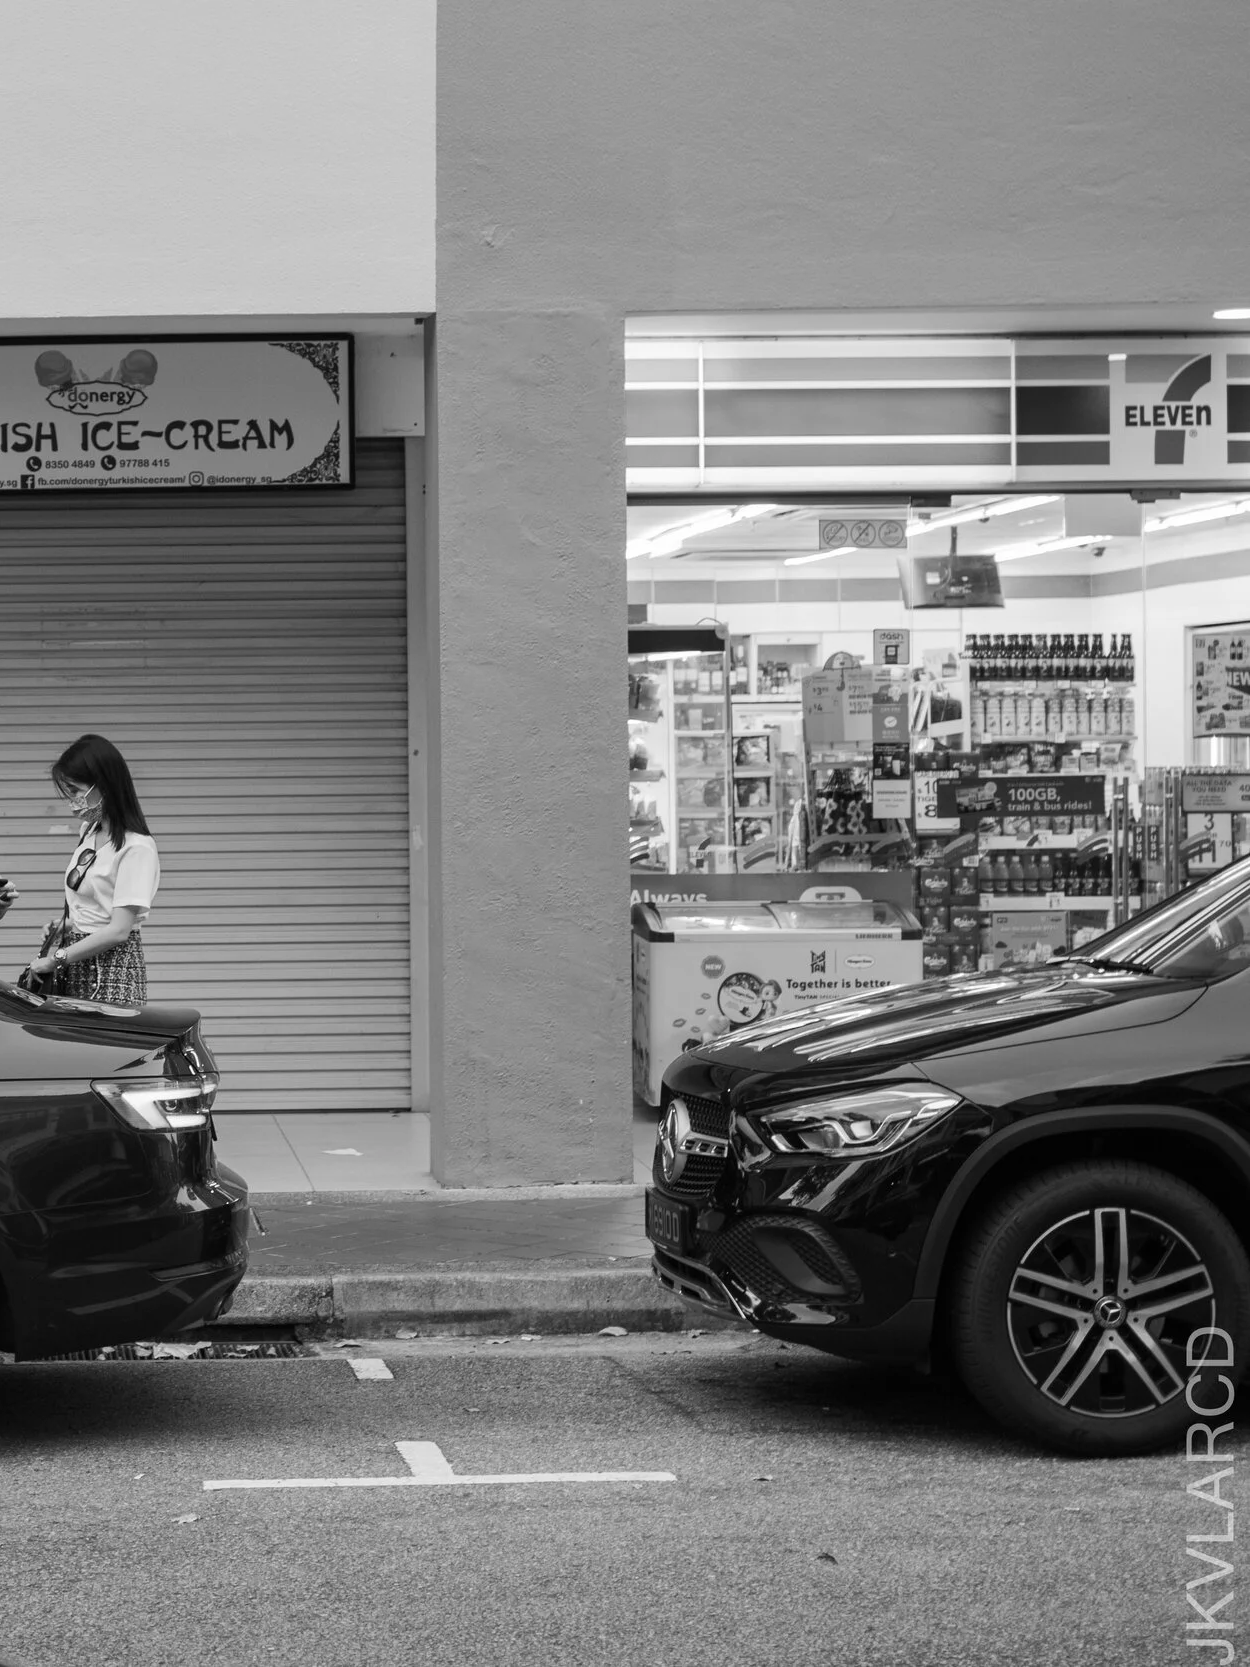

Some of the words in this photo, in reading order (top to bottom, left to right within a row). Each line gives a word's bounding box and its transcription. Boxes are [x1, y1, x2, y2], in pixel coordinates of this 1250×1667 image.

[45, 459, 69, 469] 8350
[71, 459, 96, 469] 4849
[119, 458, 150, 468] 97788
[151, 458, 171, 468] 415
[37, 474, 186, 487] fb.com/donergyturkishicecream/
[1008, 787, 1061, 801] 100GB,
[1007, 801, 1031, 811] train
[1033, 801, 1041, 811] &
[1044, 801, 1062, 811] bus
[1064, 800, 1092, 811] rides!
[786, 978, 838, 991] Together
[841, 978, 851, 989] is
